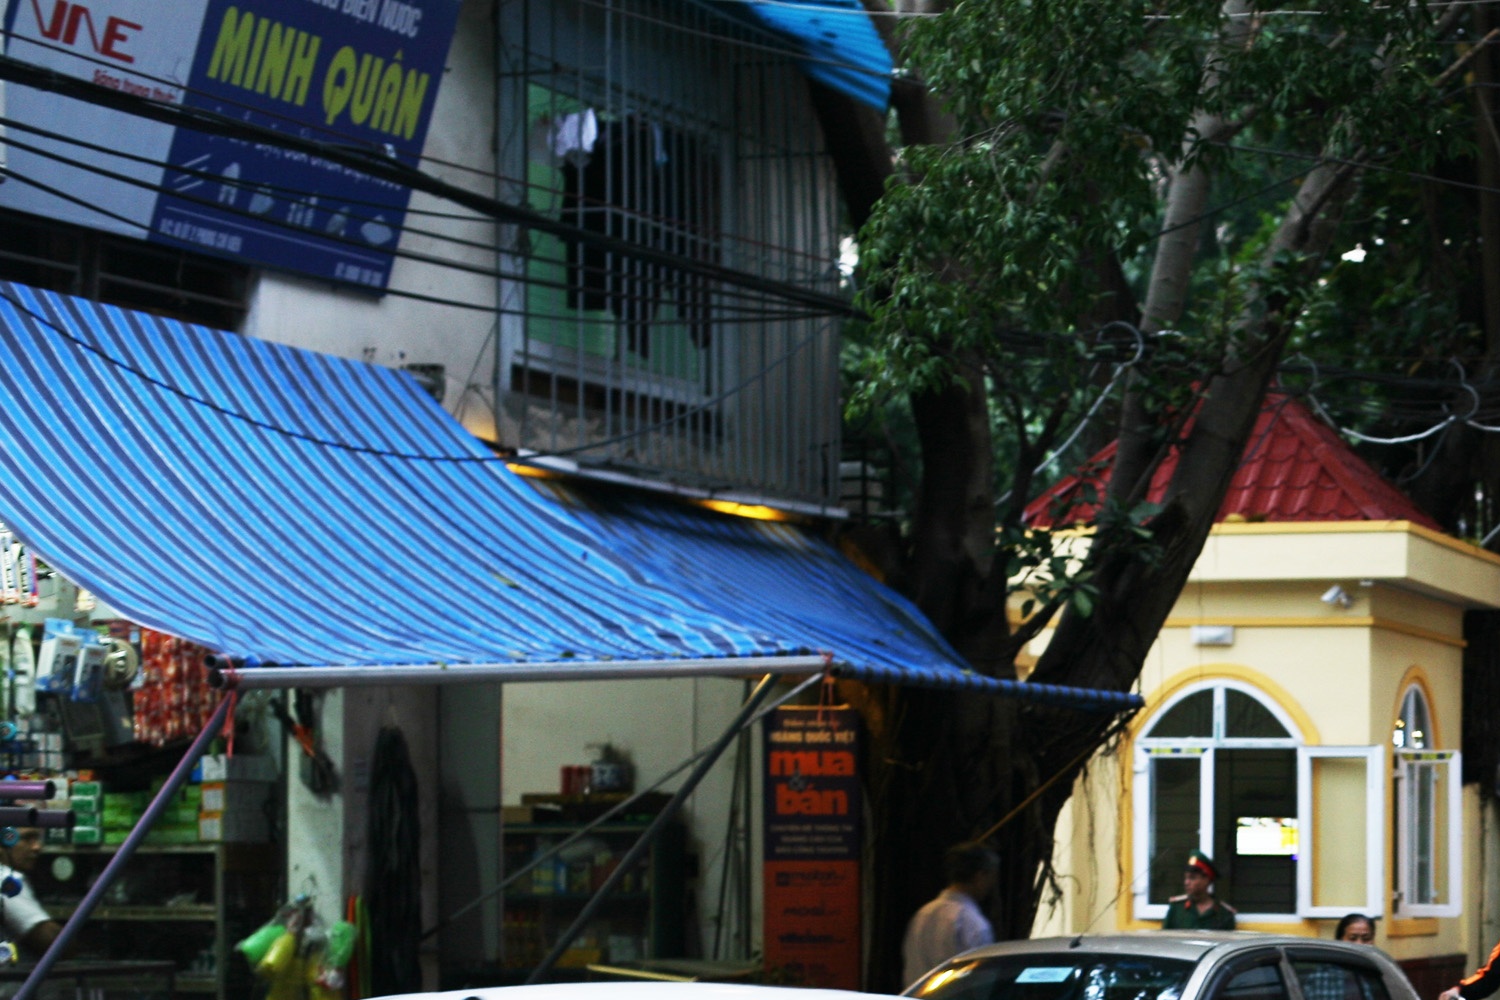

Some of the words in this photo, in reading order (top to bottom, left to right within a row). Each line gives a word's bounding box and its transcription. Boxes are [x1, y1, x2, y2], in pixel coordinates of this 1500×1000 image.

[207, 6, 322, 107] MINH
[322, 50, 431, 141] QUÂN
[769, 751, 855, 776] mua
[775, 782, 848, 815] bán
